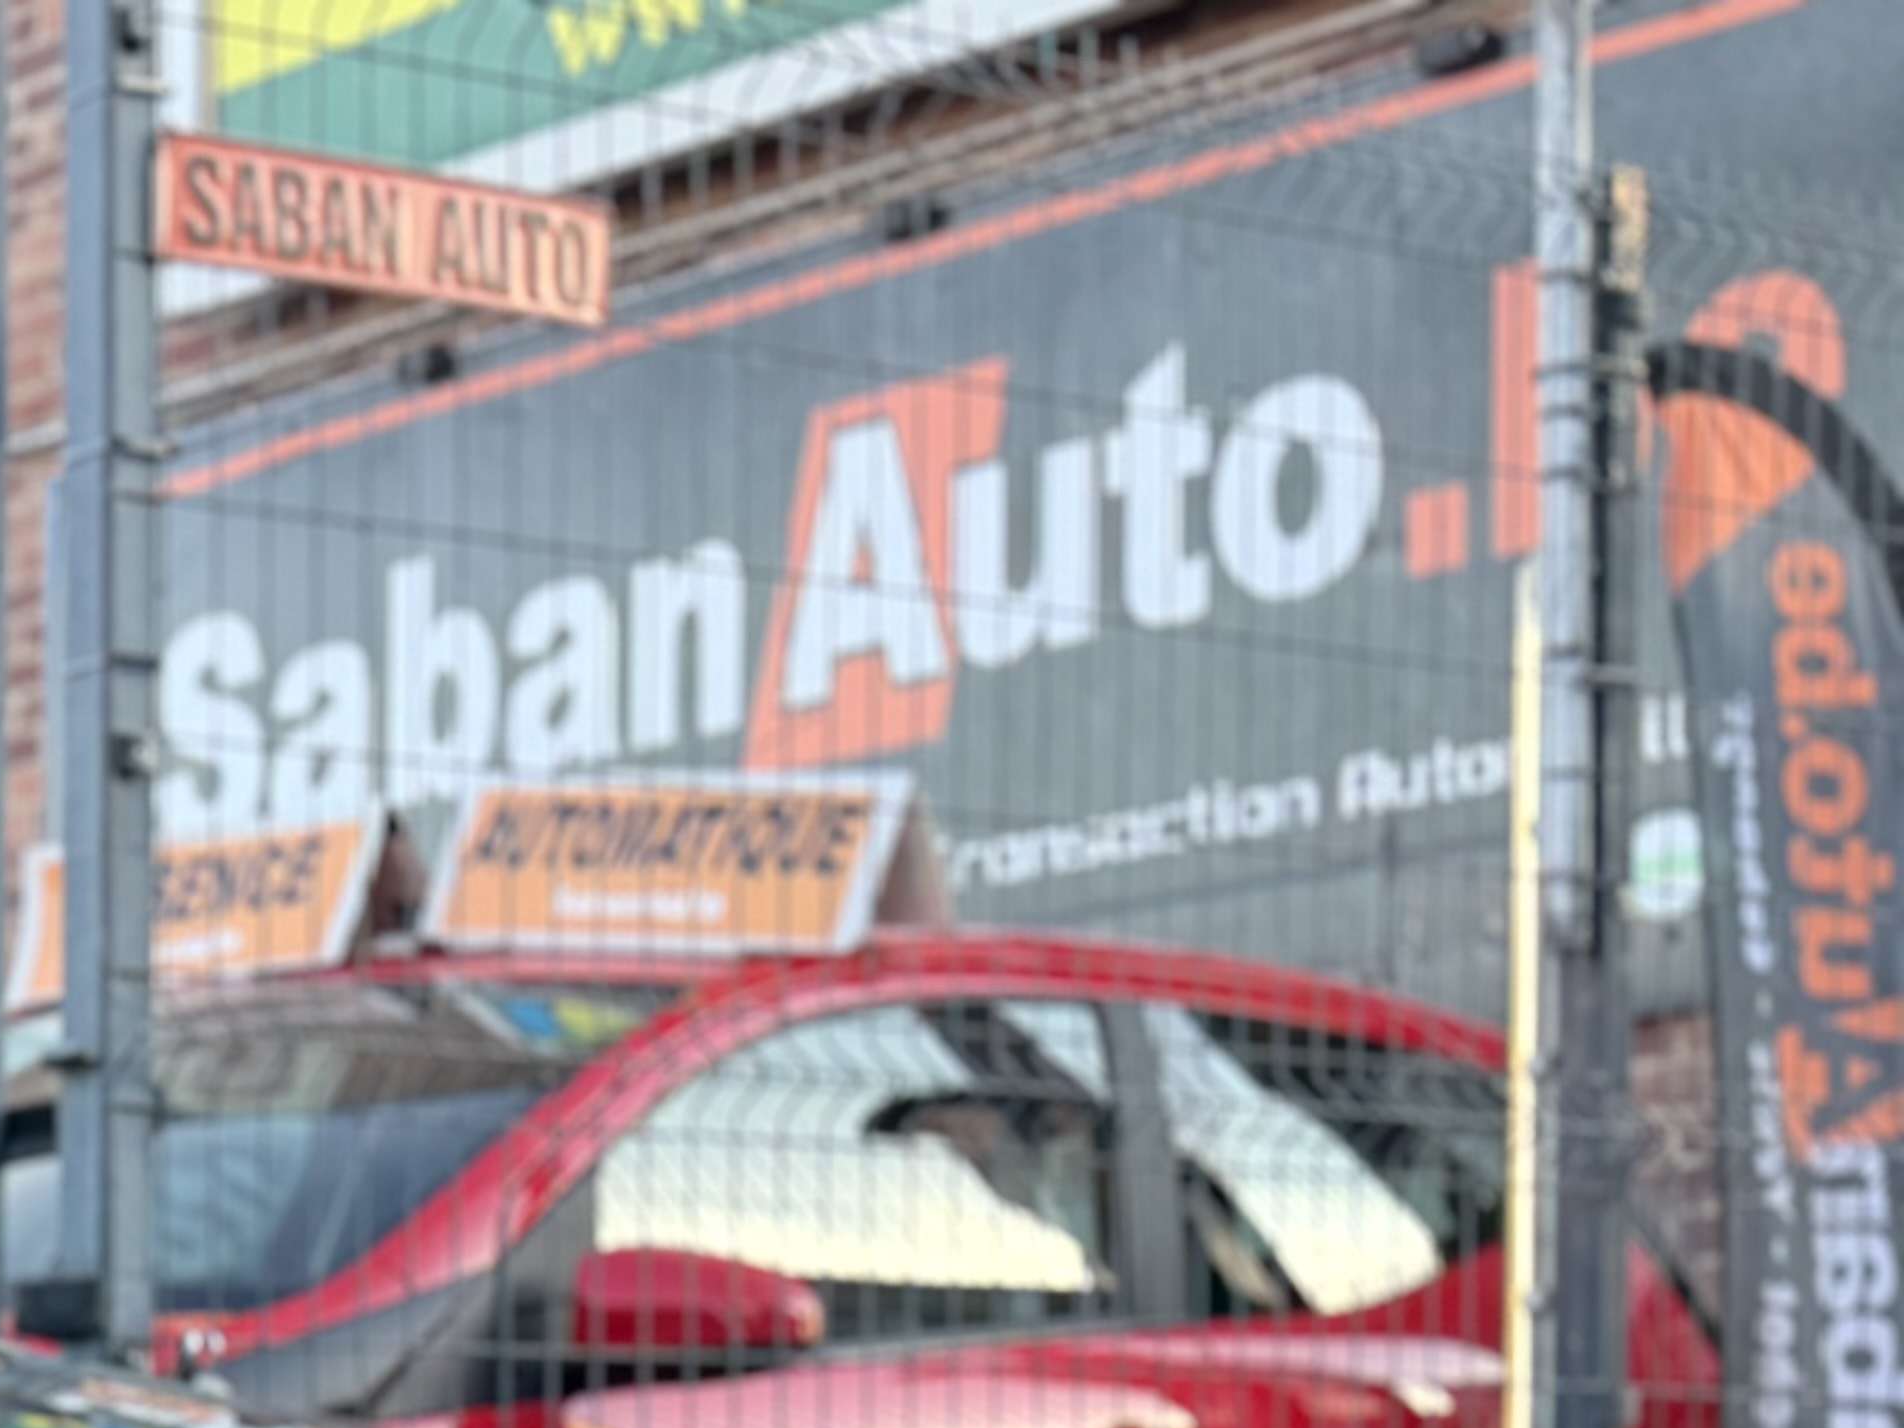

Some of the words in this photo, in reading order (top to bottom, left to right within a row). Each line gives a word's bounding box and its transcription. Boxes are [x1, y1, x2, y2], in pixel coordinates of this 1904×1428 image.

[182, 153, 400, 278] SABAN
[430, 194, 590, 308] AUTO
[474, 800, 872, 875] AUTOMATIQUE
[942, 770, 1322, 892] ransaction
